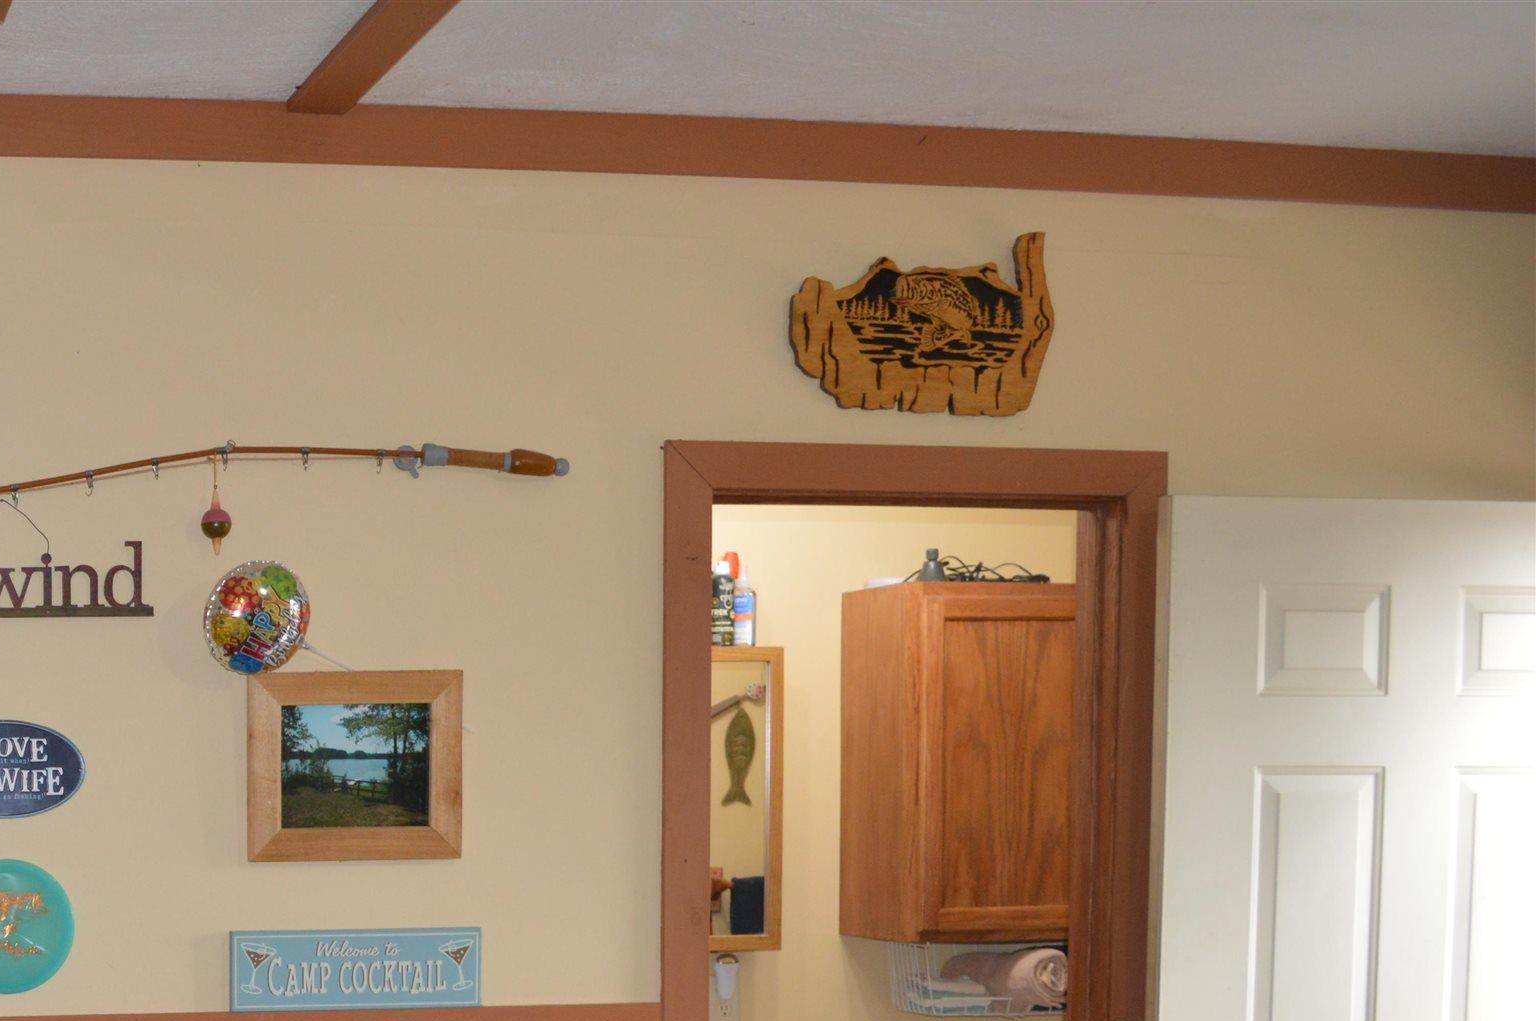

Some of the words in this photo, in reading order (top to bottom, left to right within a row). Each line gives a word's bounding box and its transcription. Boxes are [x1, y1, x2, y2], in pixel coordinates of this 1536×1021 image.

[240, 584, 290, 662] HAPPY
[315, 941, 381, 957] Welcome
[384, 941, 400, 957] to
[267, 956, 331, 997] CAMP
[338, 959, 448, 996] COCKTAIL
